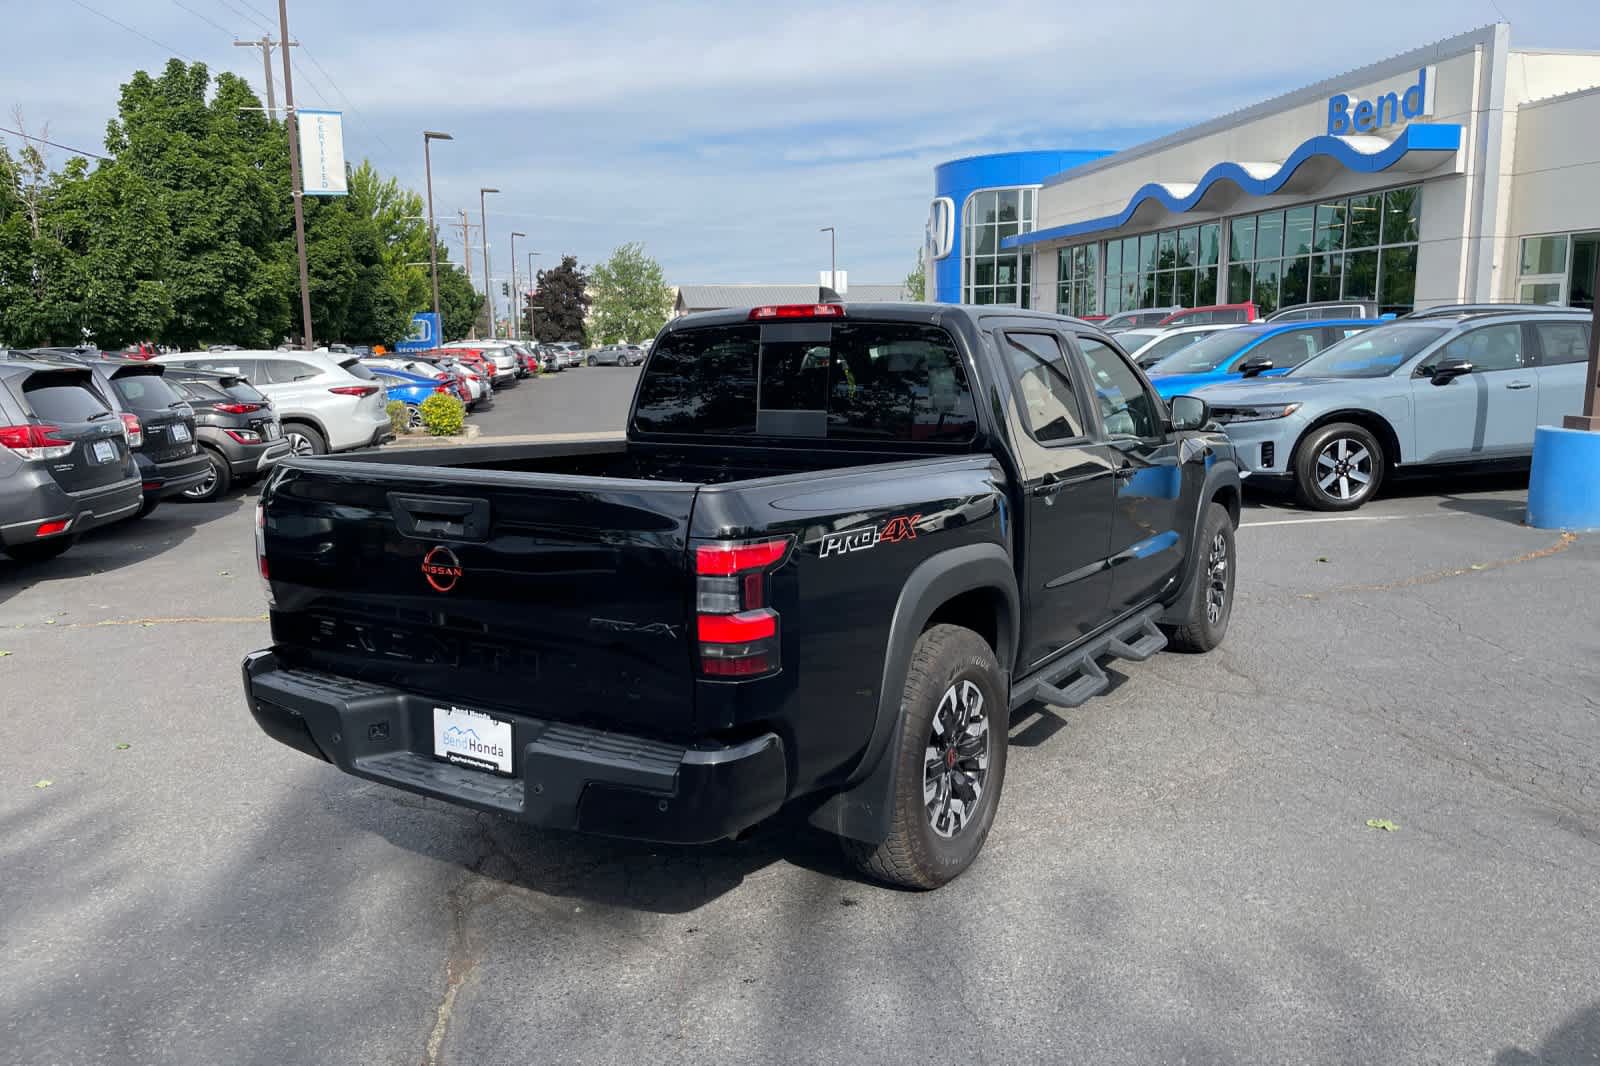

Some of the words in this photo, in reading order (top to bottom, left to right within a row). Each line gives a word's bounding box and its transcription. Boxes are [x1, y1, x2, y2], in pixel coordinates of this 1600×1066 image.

[1327, 67, 1426, 136] Bend
[317, 116, 329, 189] CERTIFIED
[421, 564, 463, 577] NISSAN
